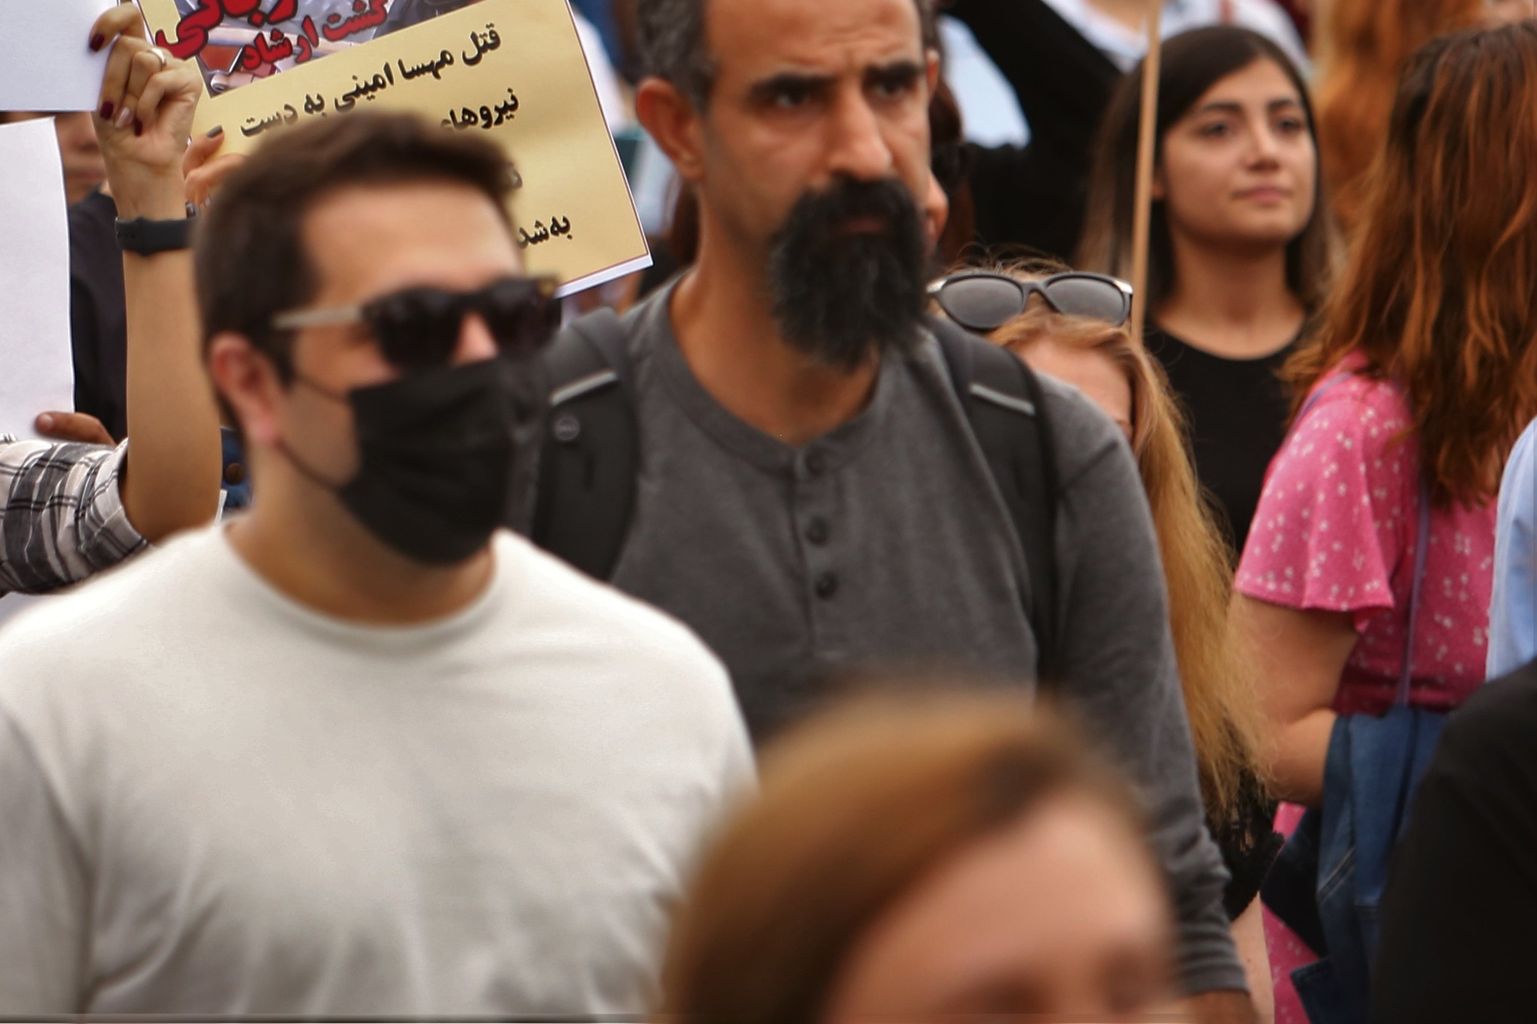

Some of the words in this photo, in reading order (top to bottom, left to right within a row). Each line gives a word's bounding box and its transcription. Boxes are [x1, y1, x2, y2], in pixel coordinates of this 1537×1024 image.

[240, 15, 319, 70] ارشاد
[462, 23, 502, 66] قتل
[397, 46, 454, 80] مهسا
[304, 93, 326, 117] به
[334, 62, 394, 112] امینی
[241, 103, 297, 137] دست
